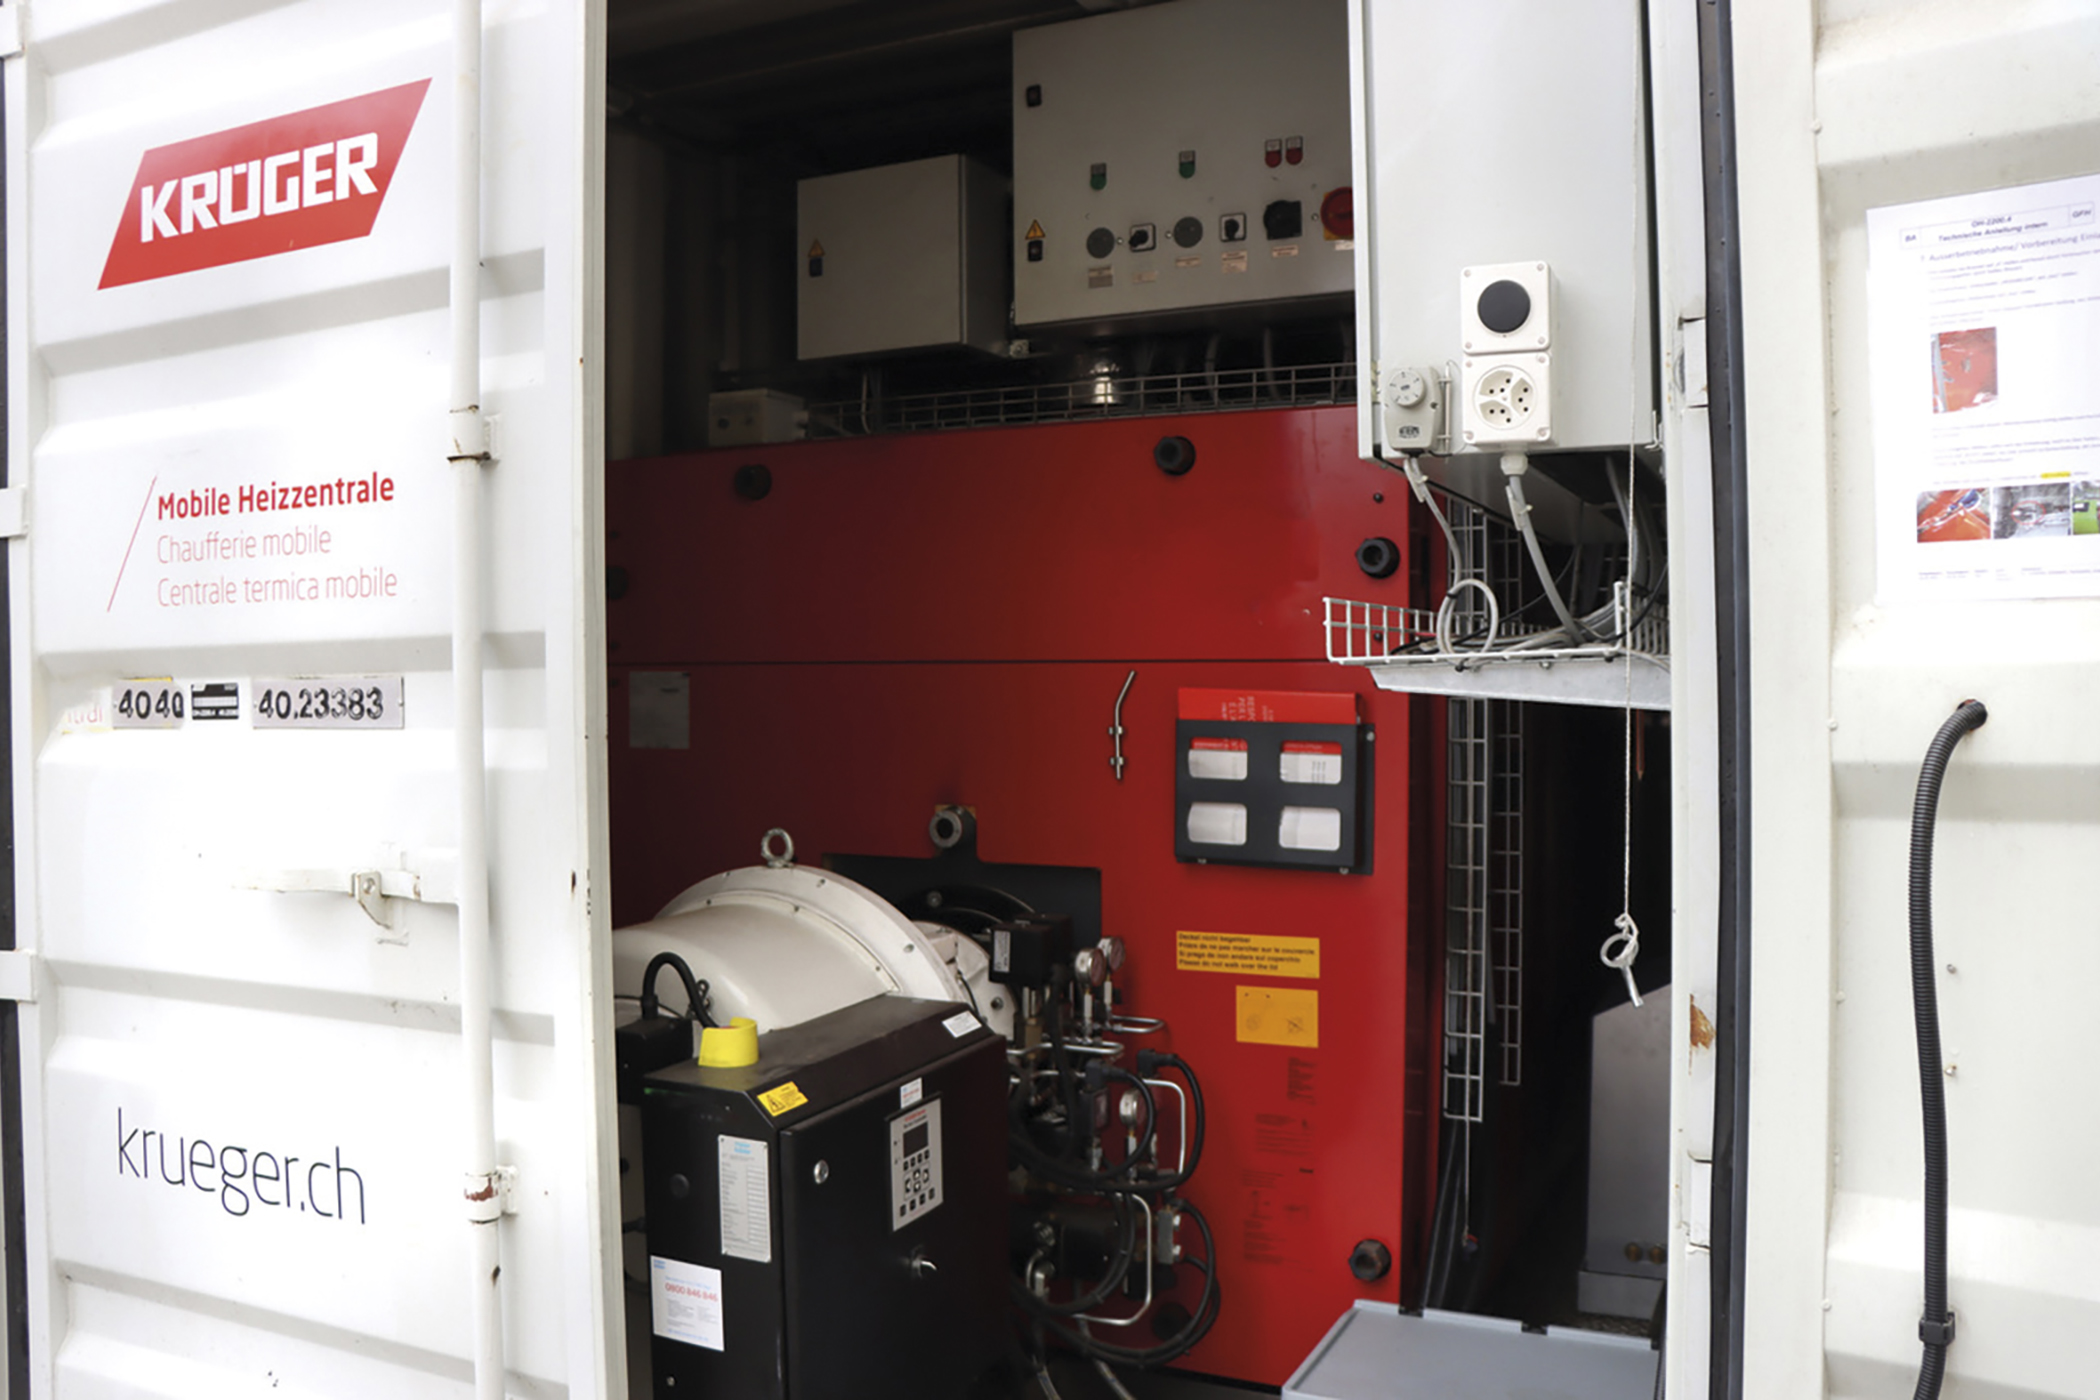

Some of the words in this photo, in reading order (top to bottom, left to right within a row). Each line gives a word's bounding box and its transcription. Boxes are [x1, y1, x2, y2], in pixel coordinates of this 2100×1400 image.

[142, 133, 378, 243] KRÜGER
[1984, 226, 2022, 236] Anleitung
[158, 486, 231, 521] Mobile
[238, 471, 395, 514] Heizzentrale
[157, 530, 257, 564] Chaufferie
[262, 524, 332, 556] mobile
[157, 573, 237, 607] Centrale
[243, 572, 319, 602] termica
[325, 567, 398, 600] mobile
[118, 1107, 365, 1225] krueger.ch
